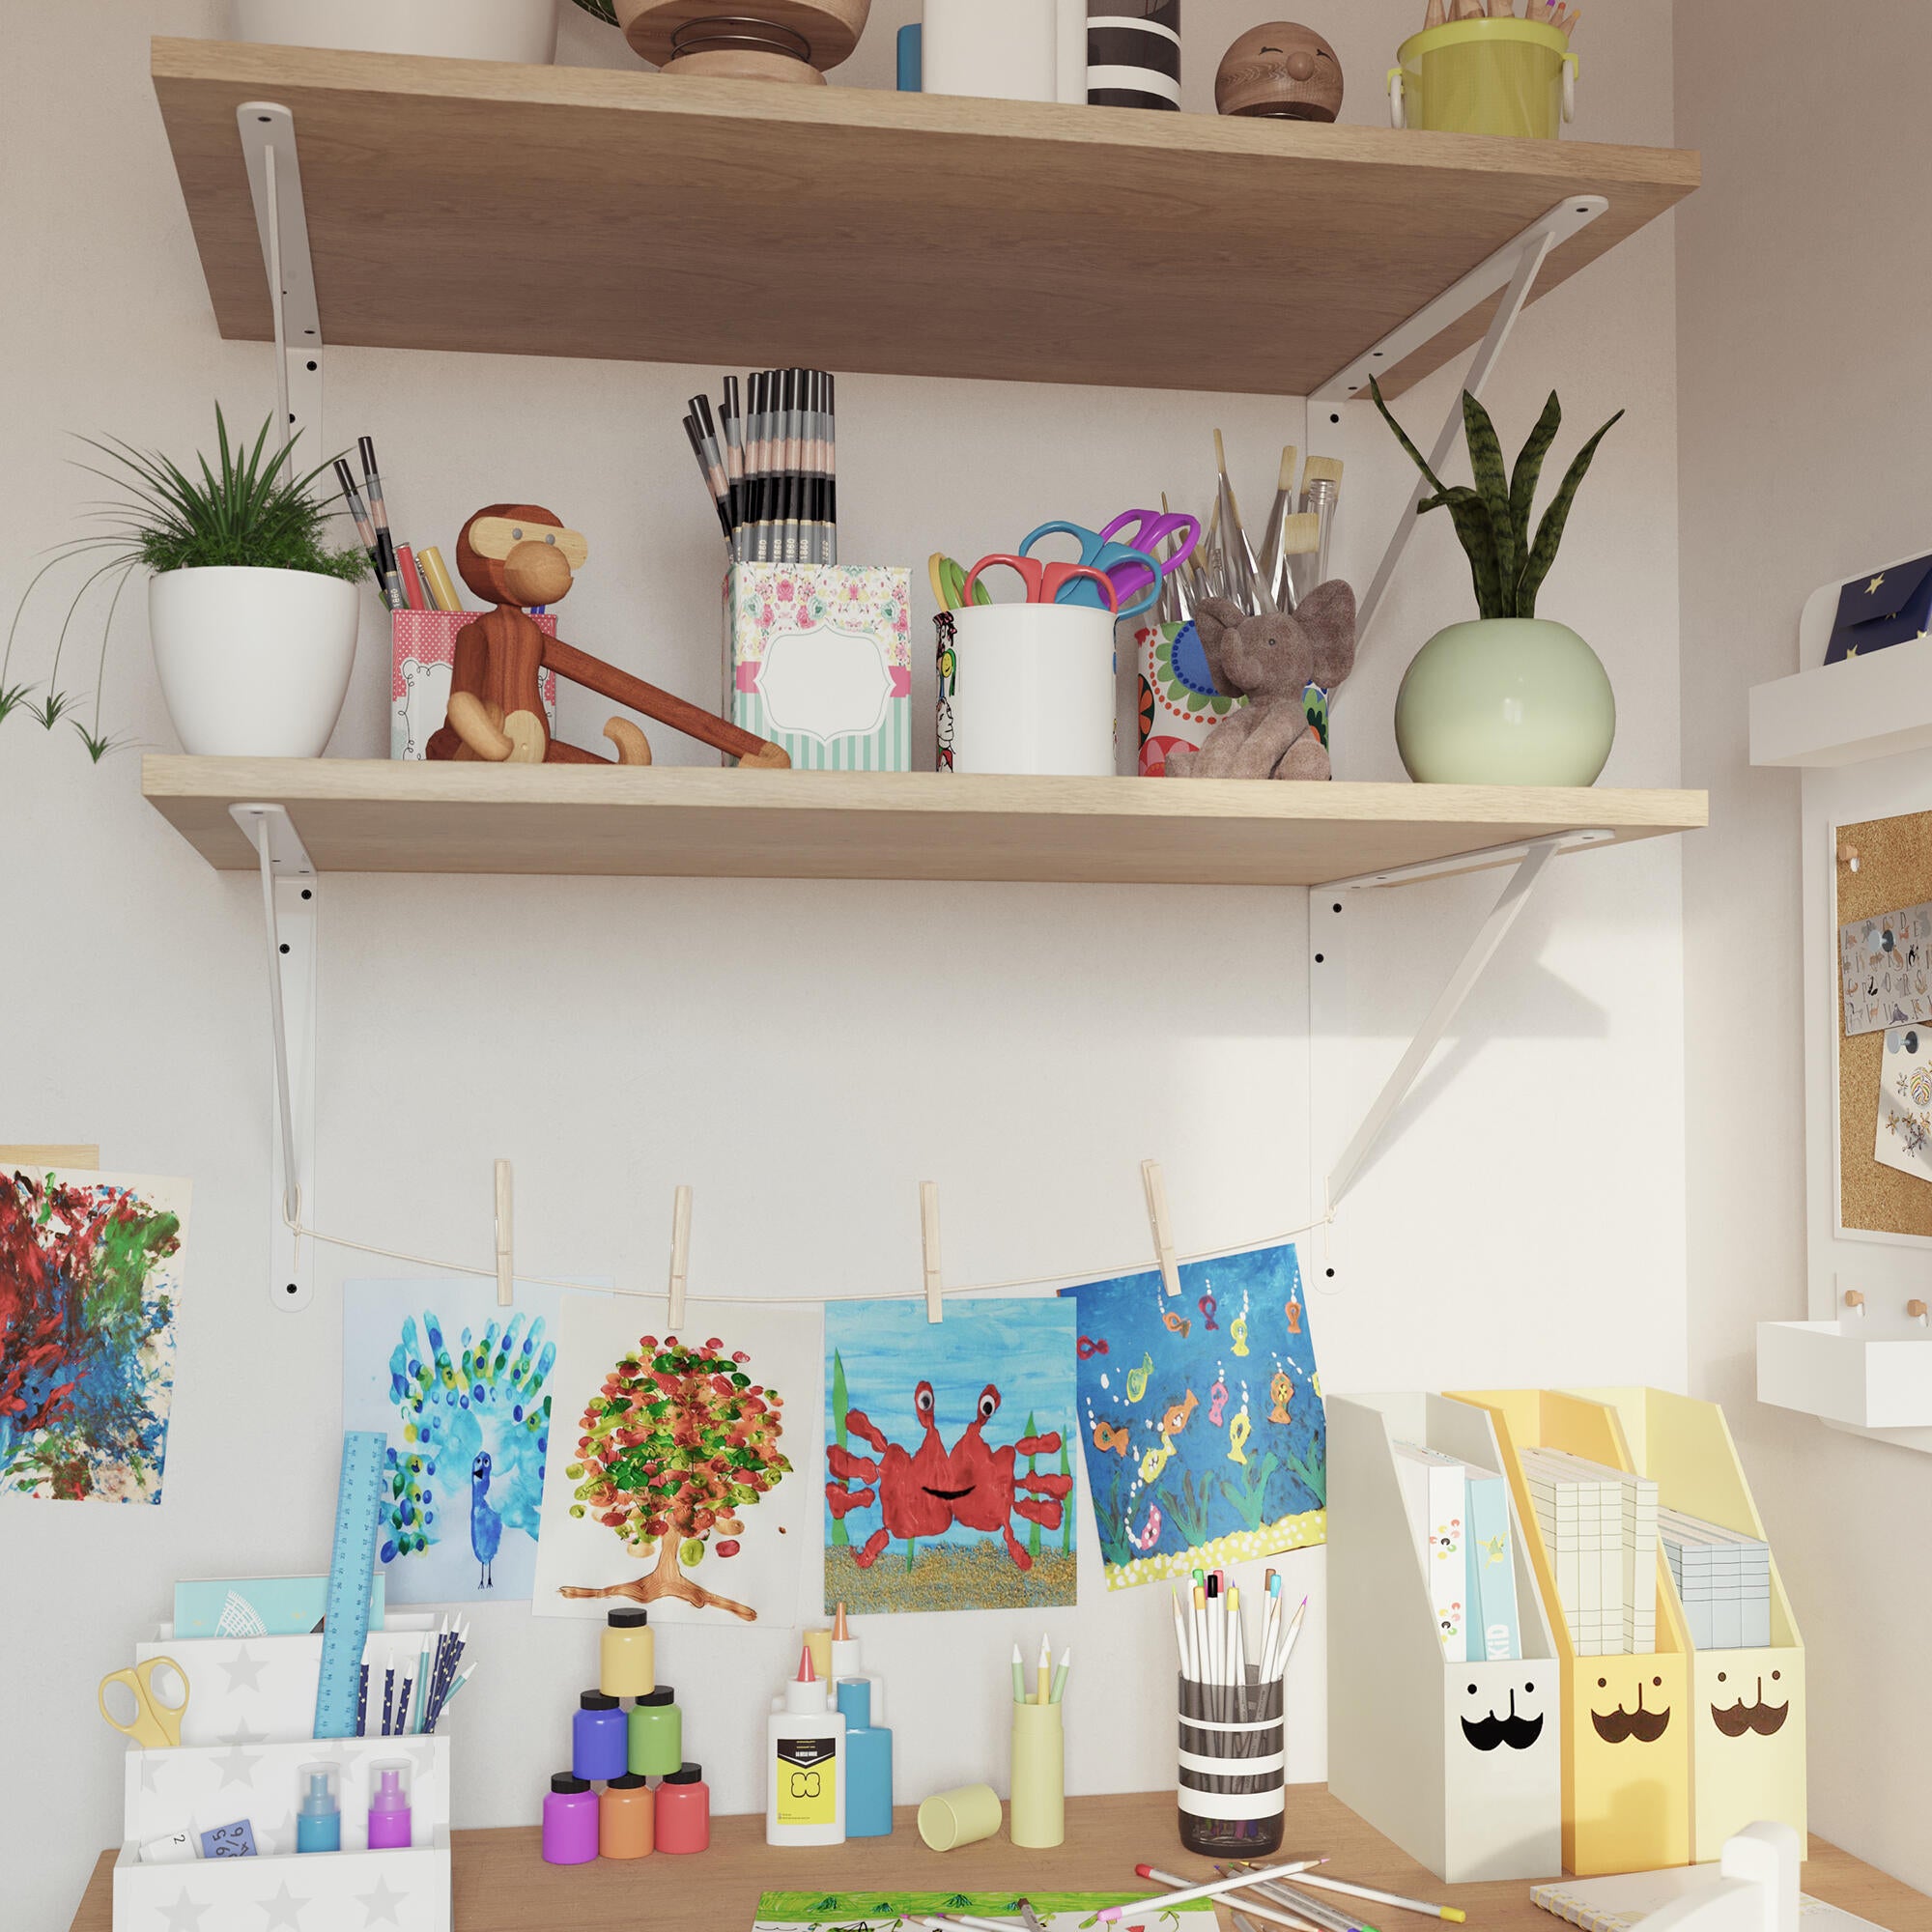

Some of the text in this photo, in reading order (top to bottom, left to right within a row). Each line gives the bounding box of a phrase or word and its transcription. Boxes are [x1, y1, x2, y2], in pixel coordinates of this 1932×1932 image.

[758, 539, 767, 560] 1860
[774, 539, 782, 559] 1860
[786, 538, 795, 558] 1860
[800, 539, 809, 559] 1860
[390, 588, 401, 608] 1860
[174, 1834, 185, 1844] 2
